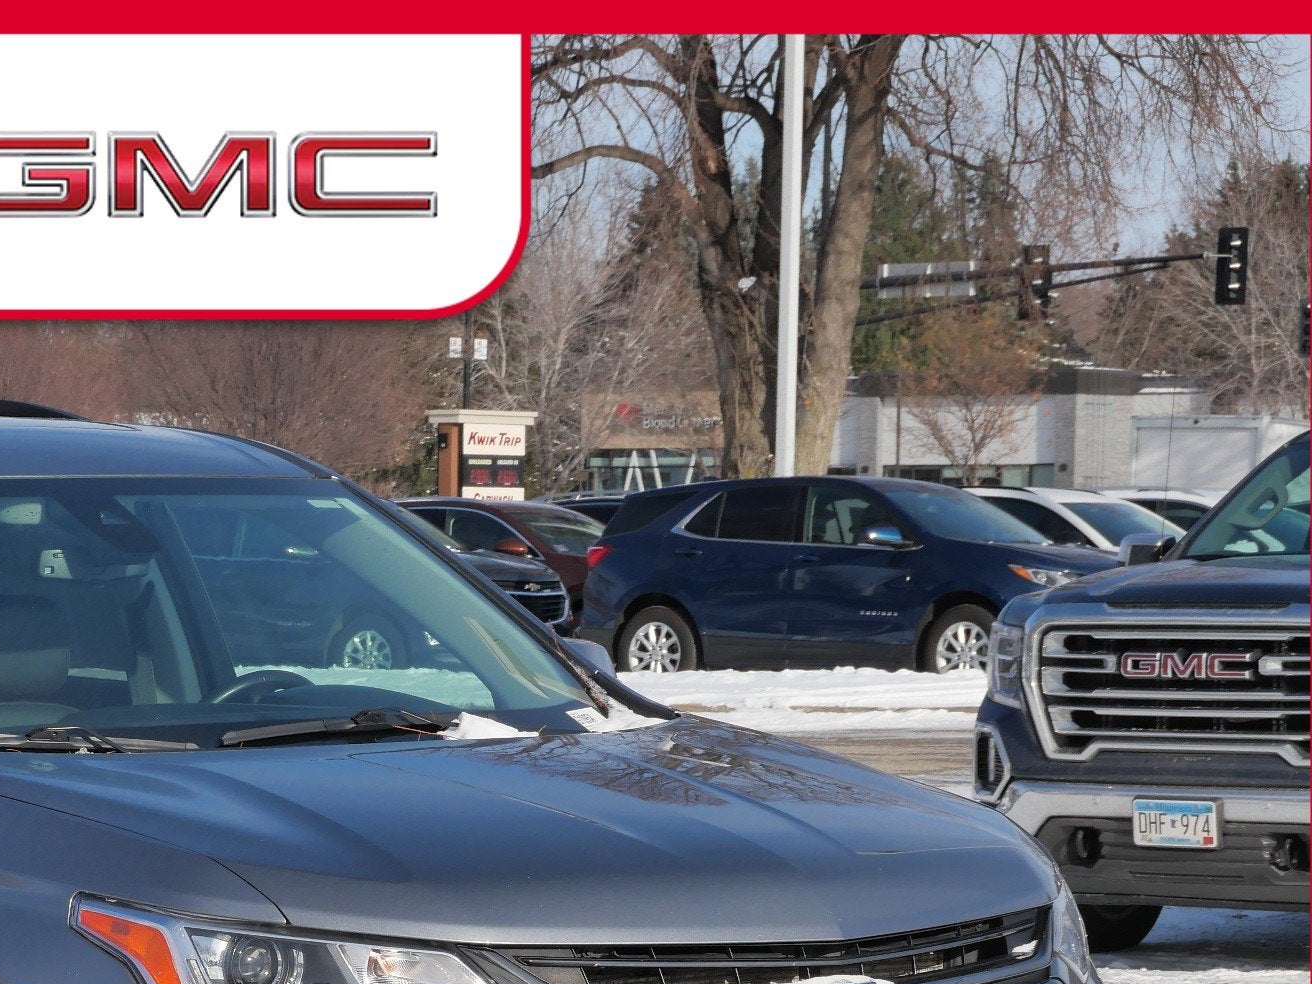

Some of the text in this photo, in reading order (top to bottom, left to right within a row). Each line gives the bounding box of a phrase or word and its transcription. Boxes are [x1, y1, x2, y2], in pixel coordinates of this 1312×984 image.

[1120, 652, 1252, 679] GMC
[1138, 812, 1211, 836] DHF 974
